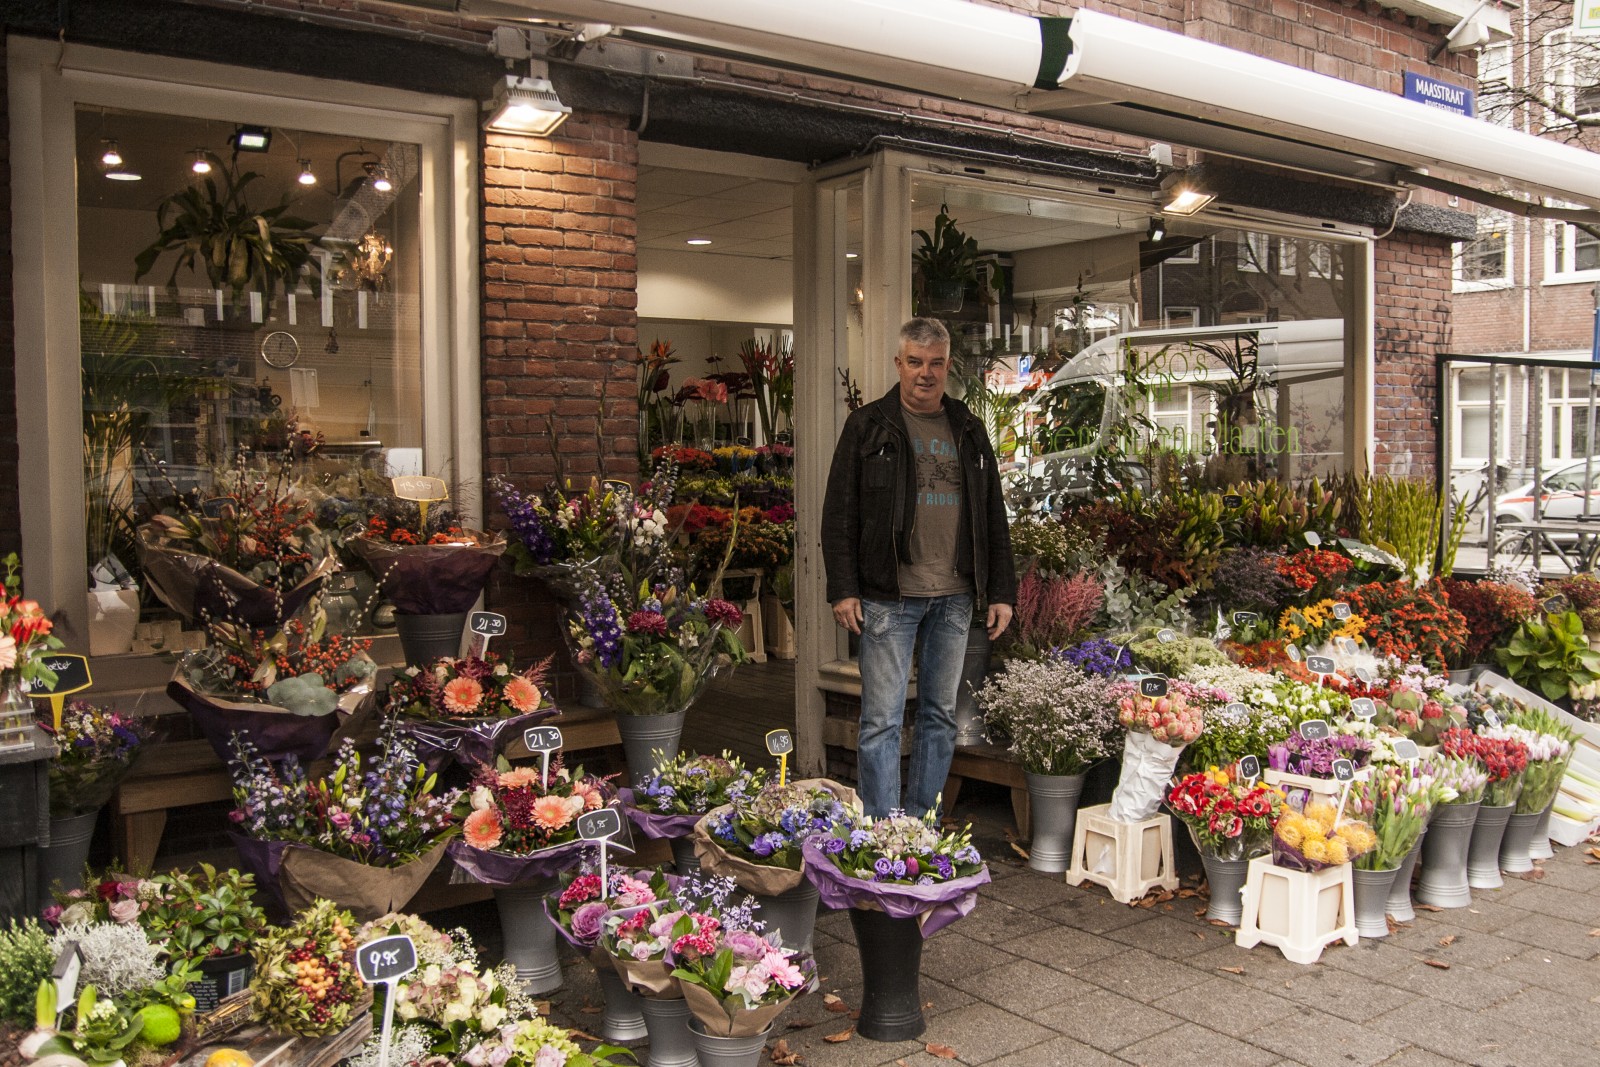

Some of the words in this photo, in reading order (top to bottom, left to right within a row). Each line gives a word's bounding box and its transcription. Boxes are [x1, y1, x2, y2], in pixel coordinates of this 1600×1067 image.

[1416, 78, 1465, 106] MAASSTRAAT
[1115, 336, 1208, 382] Hugo's
[1200, 409, 1301, 456] Planten
[528, 730, 559, 748] 21.50
[370, 948, 400, 976] 9.95
